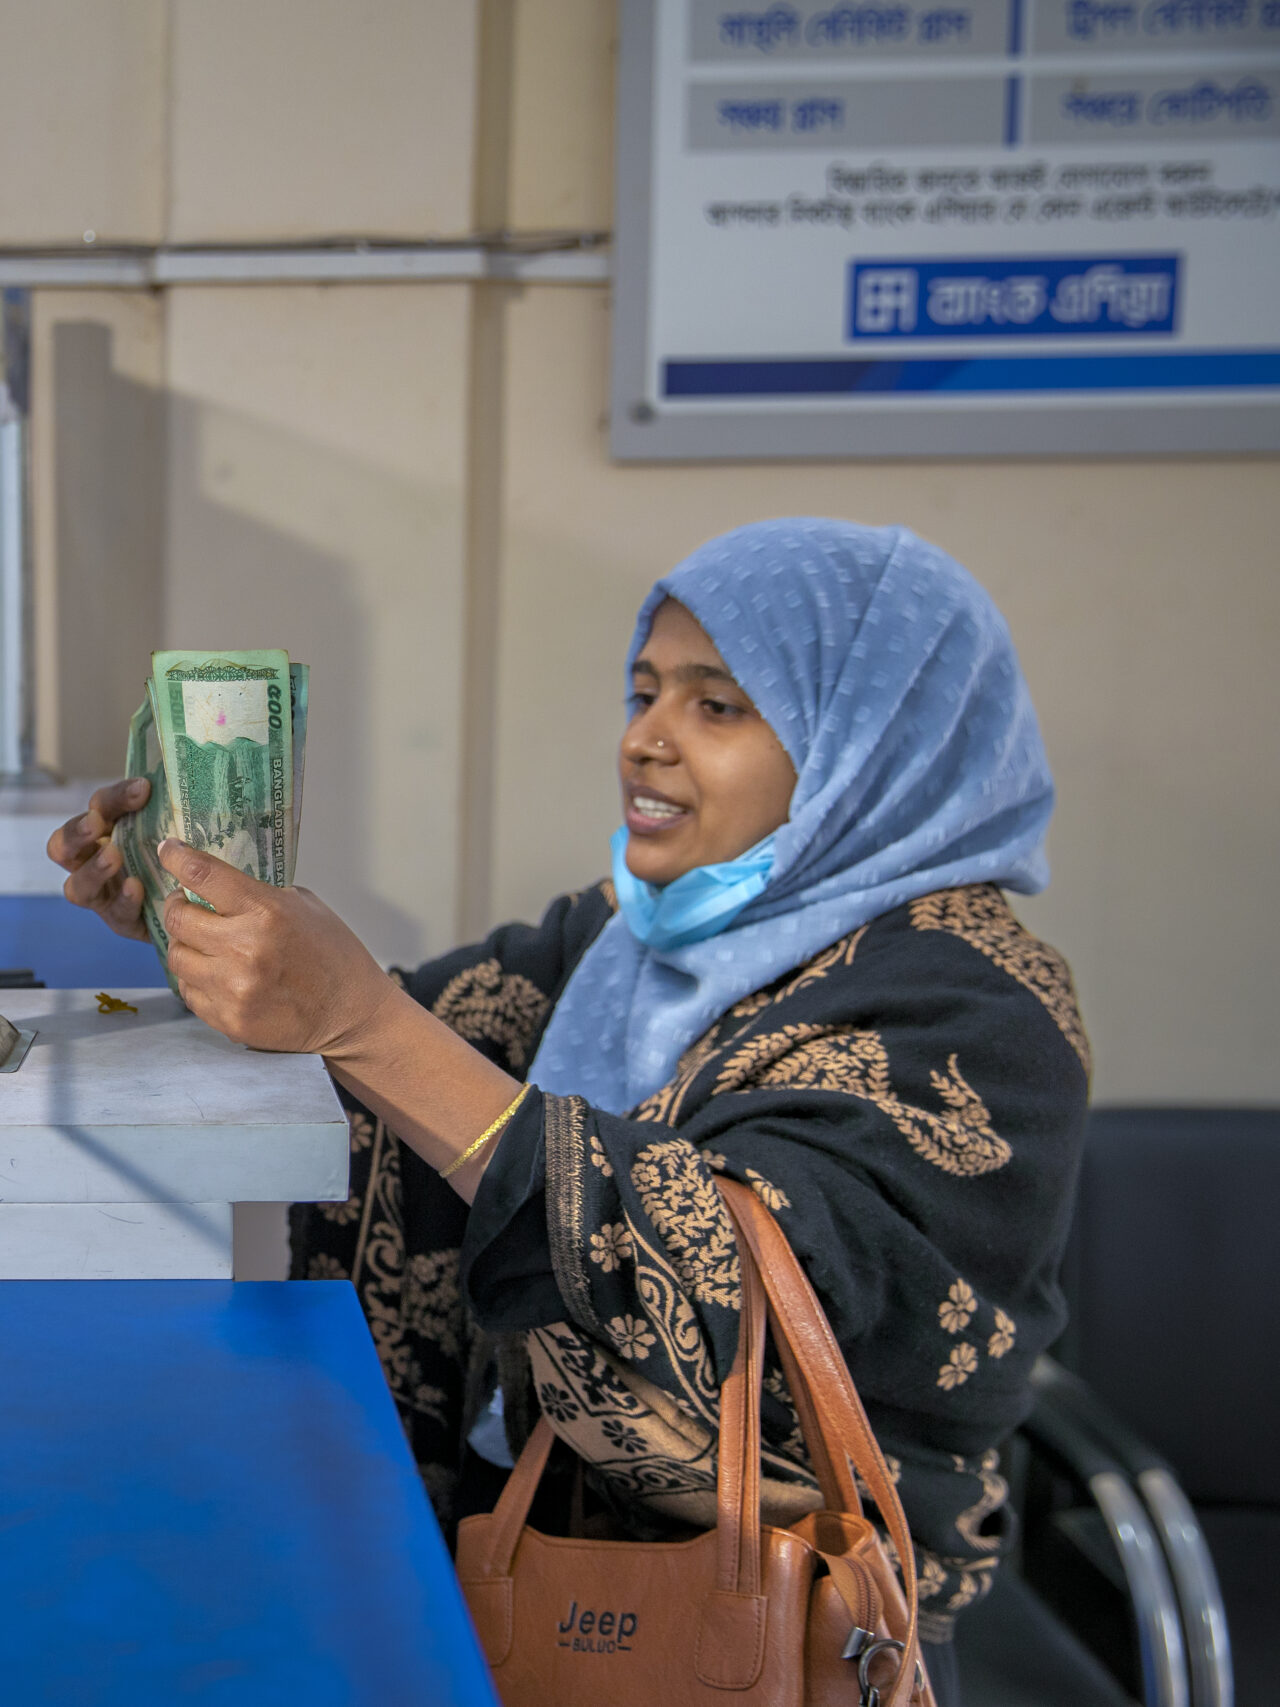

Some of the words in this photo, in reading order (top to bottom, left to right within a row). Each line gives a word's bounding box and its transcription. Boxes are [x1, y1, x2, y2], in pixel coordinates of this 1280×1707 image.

[1051, 264, 1170, 328] এশিয়া
[272, 758, 285, 858] BANGLADESH
[558, 1601, 638, 1643] Jeep
